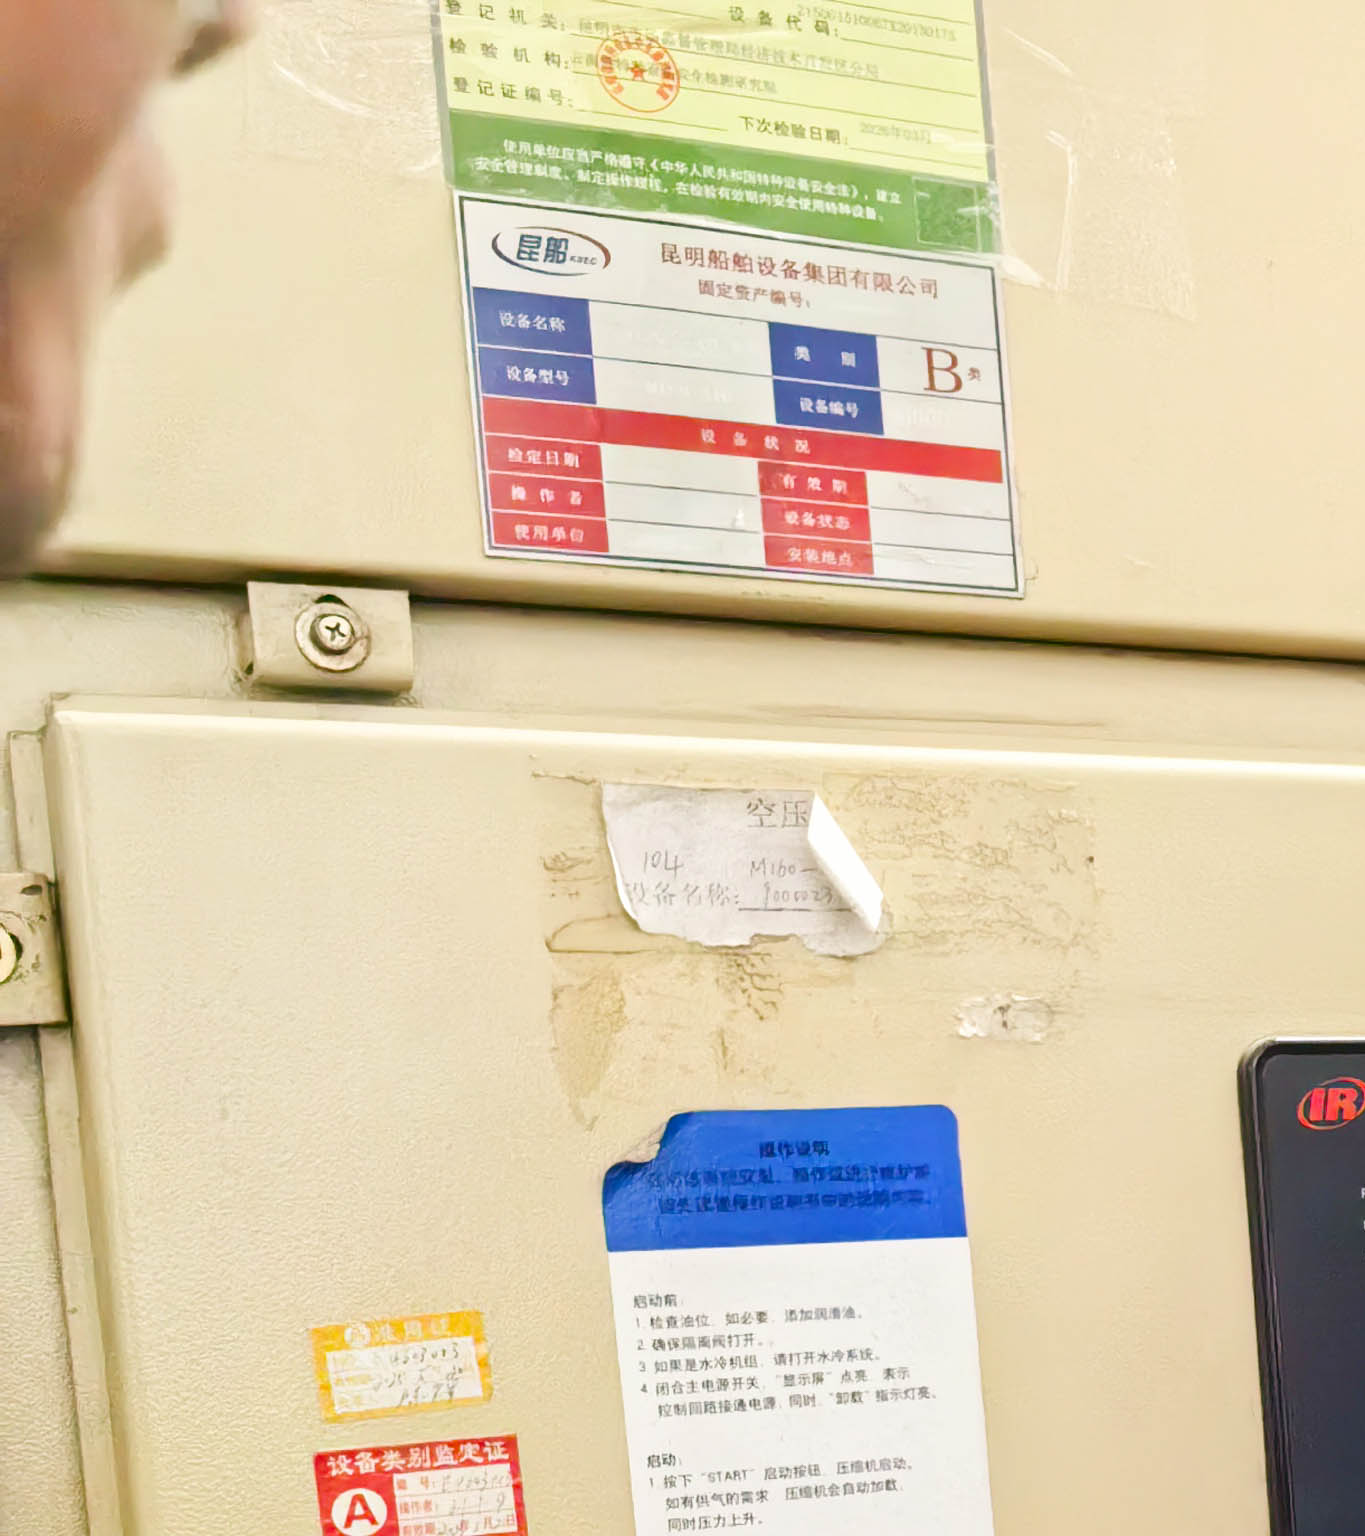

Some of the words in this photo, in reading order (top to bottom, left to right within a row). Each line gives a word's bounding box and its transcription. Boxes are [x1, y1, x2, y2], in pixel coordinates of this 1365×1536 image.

[516, 234, 569, 265] 昆船
[661, 243, 938, 299] 昆明船舶设备集团有限公司
[499, 309, 566, 333] 设备名称
[506, 365, 570, 387] 设备型号
[922, 347, 963, 393] B
[799, 397, 859, 418] 设备编号
[514, 523, 584, 543] 使用单位
[784, 511, 851, 531] 设备状态
[327, 1441, 510, 1476] 设备类别监定证
[343, 1493, 379, 1529] A
